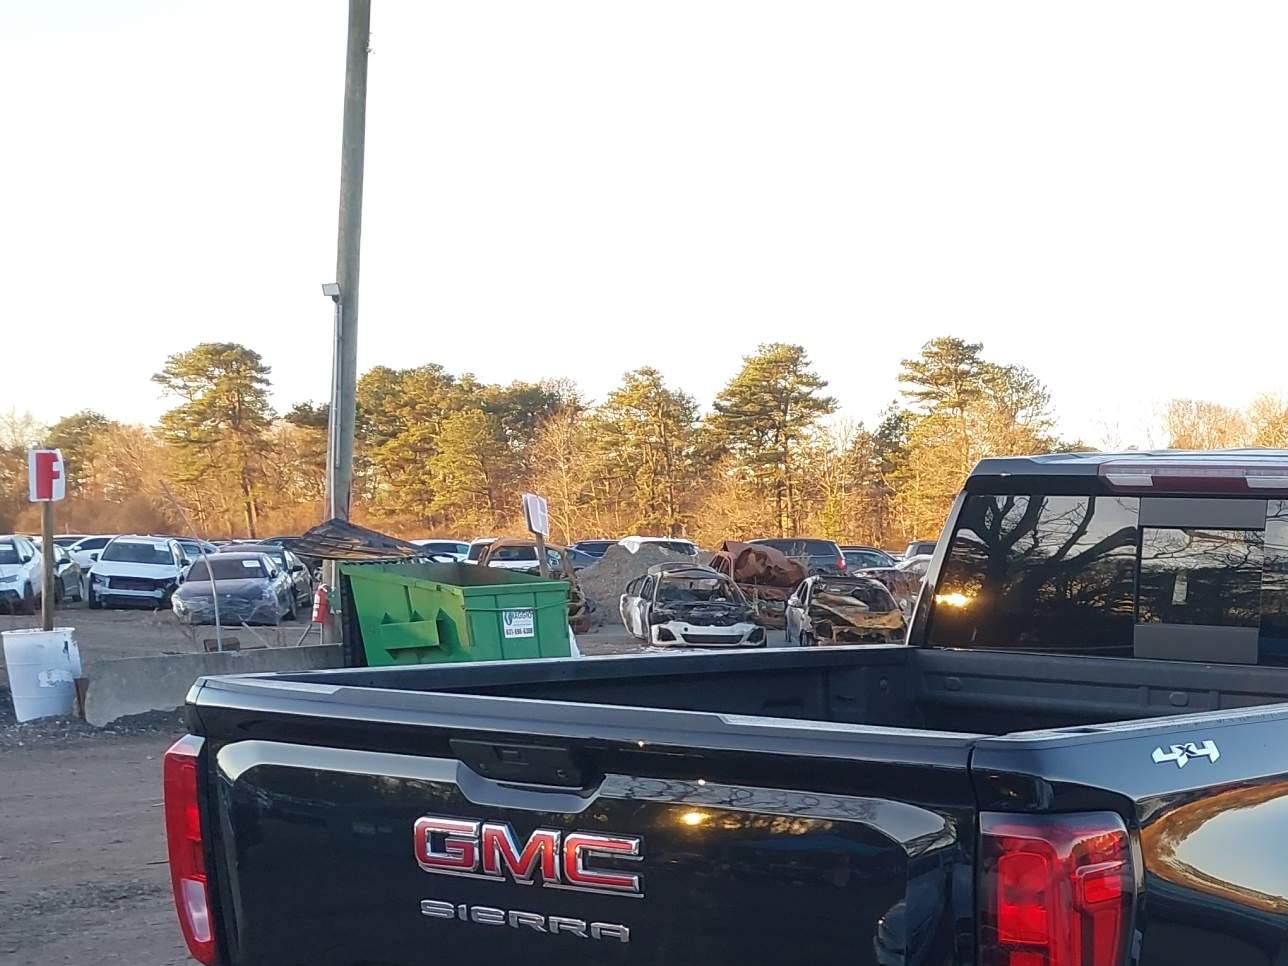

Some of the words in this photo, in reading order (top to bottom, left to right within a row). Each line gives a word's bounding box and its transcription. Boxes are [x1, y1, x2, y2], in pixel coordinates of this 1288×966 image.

[35, 452, 60, 499] F
[413, 815, 641, 893] GMC
[420, 899, 631, 943] SIERRA
